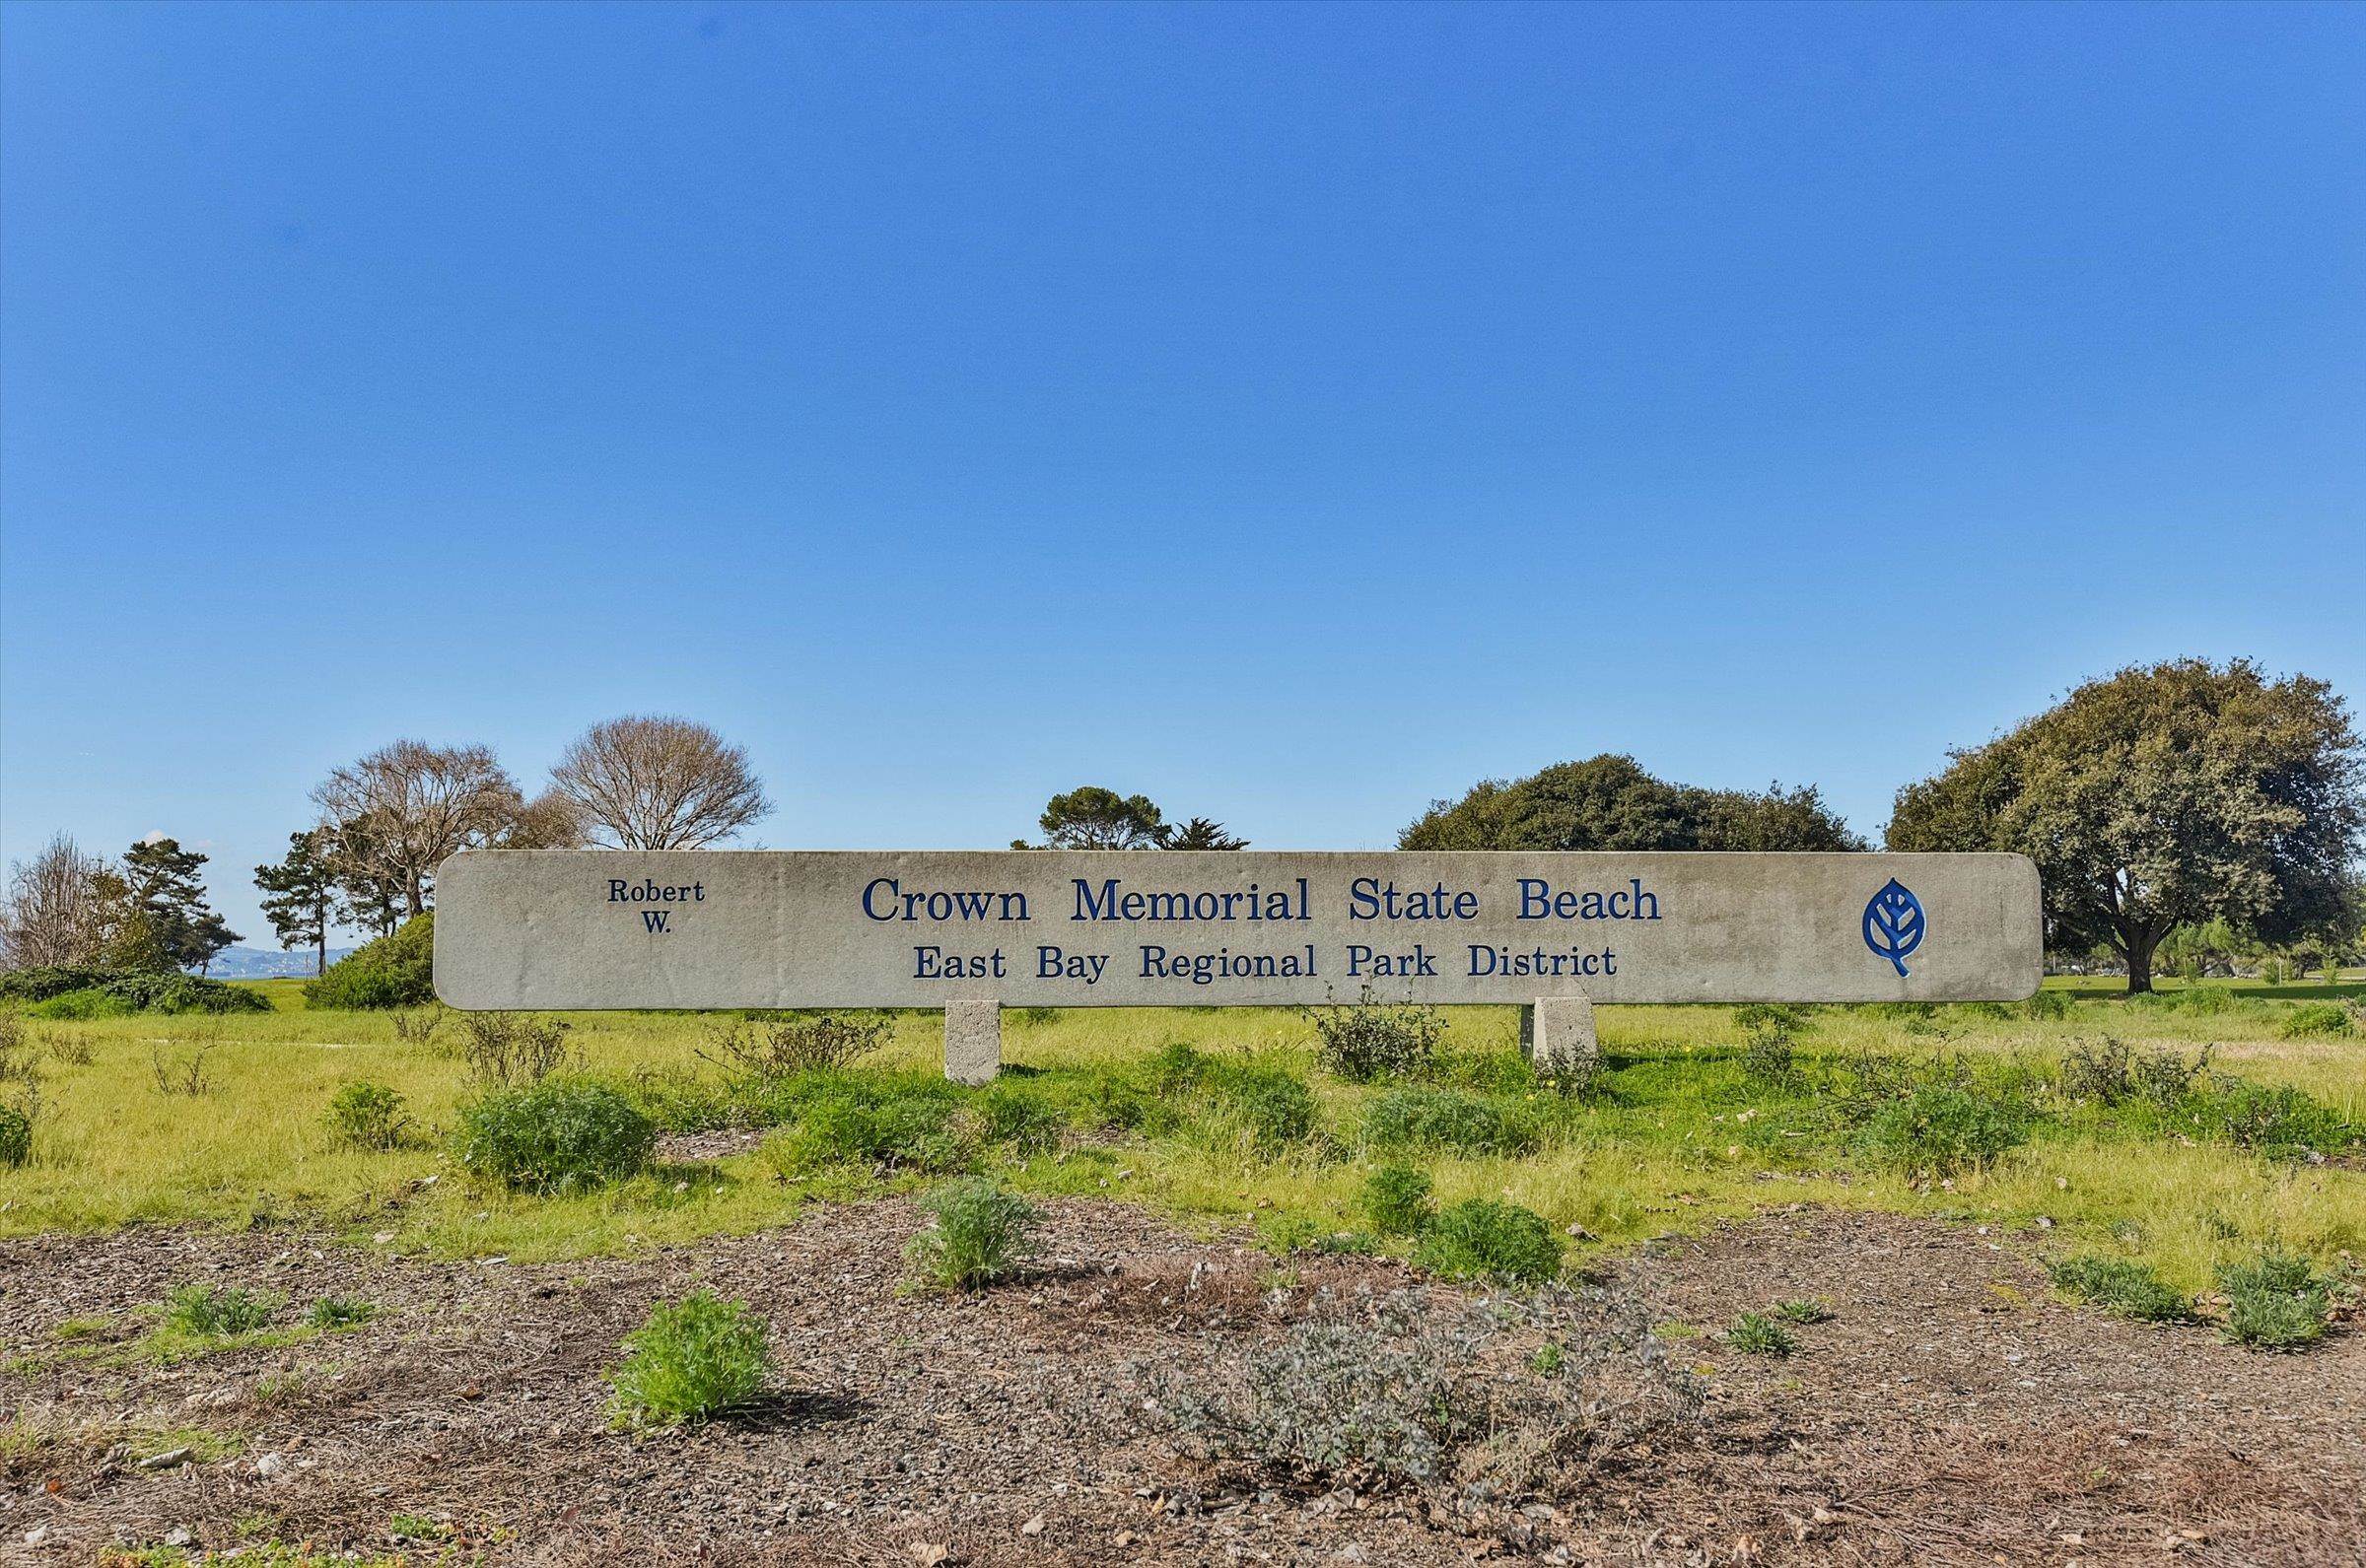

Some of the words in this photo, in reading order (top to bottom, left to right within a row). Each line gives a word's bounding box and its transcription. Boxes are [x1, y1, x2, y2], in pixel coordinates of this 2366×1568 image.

[607, 878, 706, 904] Robert
[862, 877, 1030, 922] Crown
[1071, 877, 1312, 922] Memorial
[1349, 877, 1480, 922] State
[1516, 877, 1663, 921] Beach
[641, 910, 672, 933] W.
[913, 945, 1007, 980] East
[1036, 945, 1110, 985] Bay
[1139, 944, 1318, 985] Regional
[1346, 944, 1438, 978] Park
[1467, 944, 1618, 978] District
